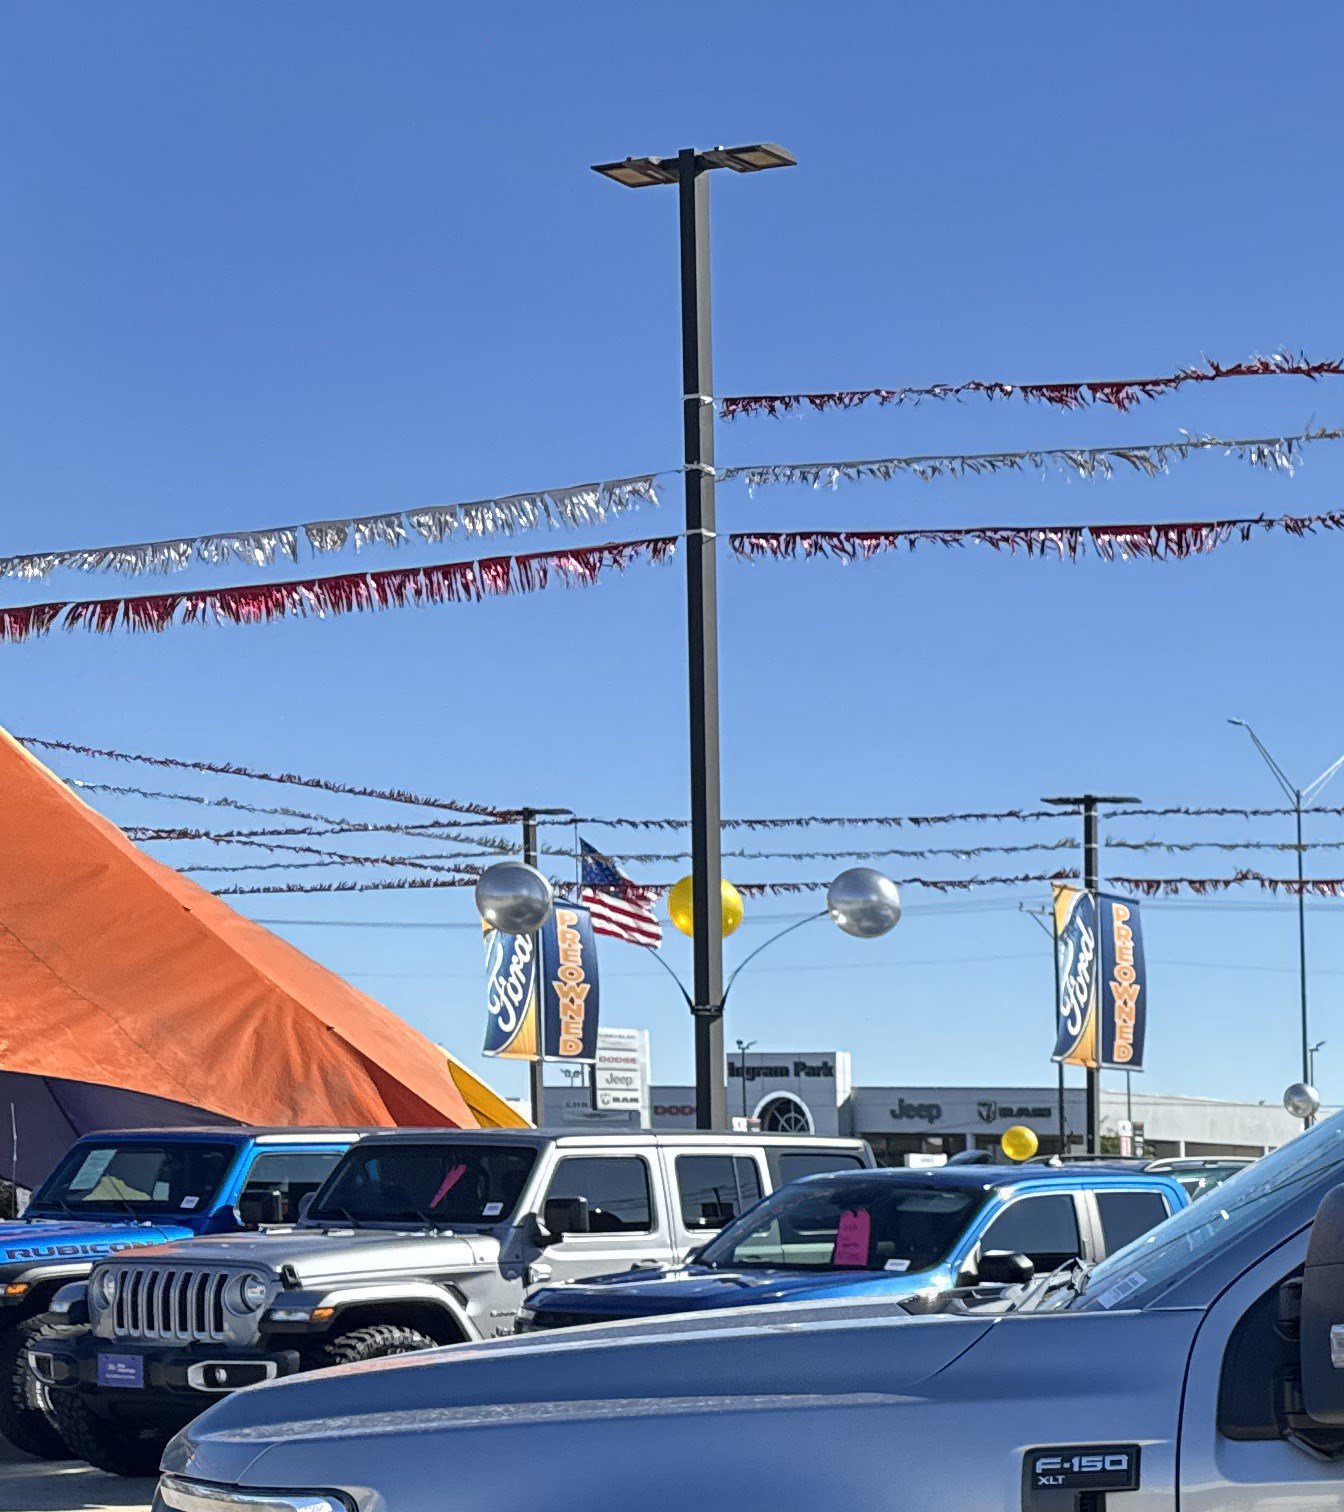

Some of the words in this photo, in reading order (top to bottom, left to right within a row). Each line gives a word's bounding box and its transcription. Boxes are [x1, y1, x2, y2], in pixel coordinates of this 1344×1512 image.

[552, 908, 591, 1056] PREOWNED
[1060, 916, 1095, 1036] Ford
[1109, 903, 1140, 1062] PREOWNED
[605, 1073, 633, 1087] Jeep
[727, 1061, 790, 1081] Ingram
[793, 1060, 834, 1077] Park
[654, 1105, 696, 1115] DOD
[890, 1098, 943, 1124] Jeep
[1036, 1454, 1128, 1473] F-150
[1038, 1475, 1065, 1485] XLT
